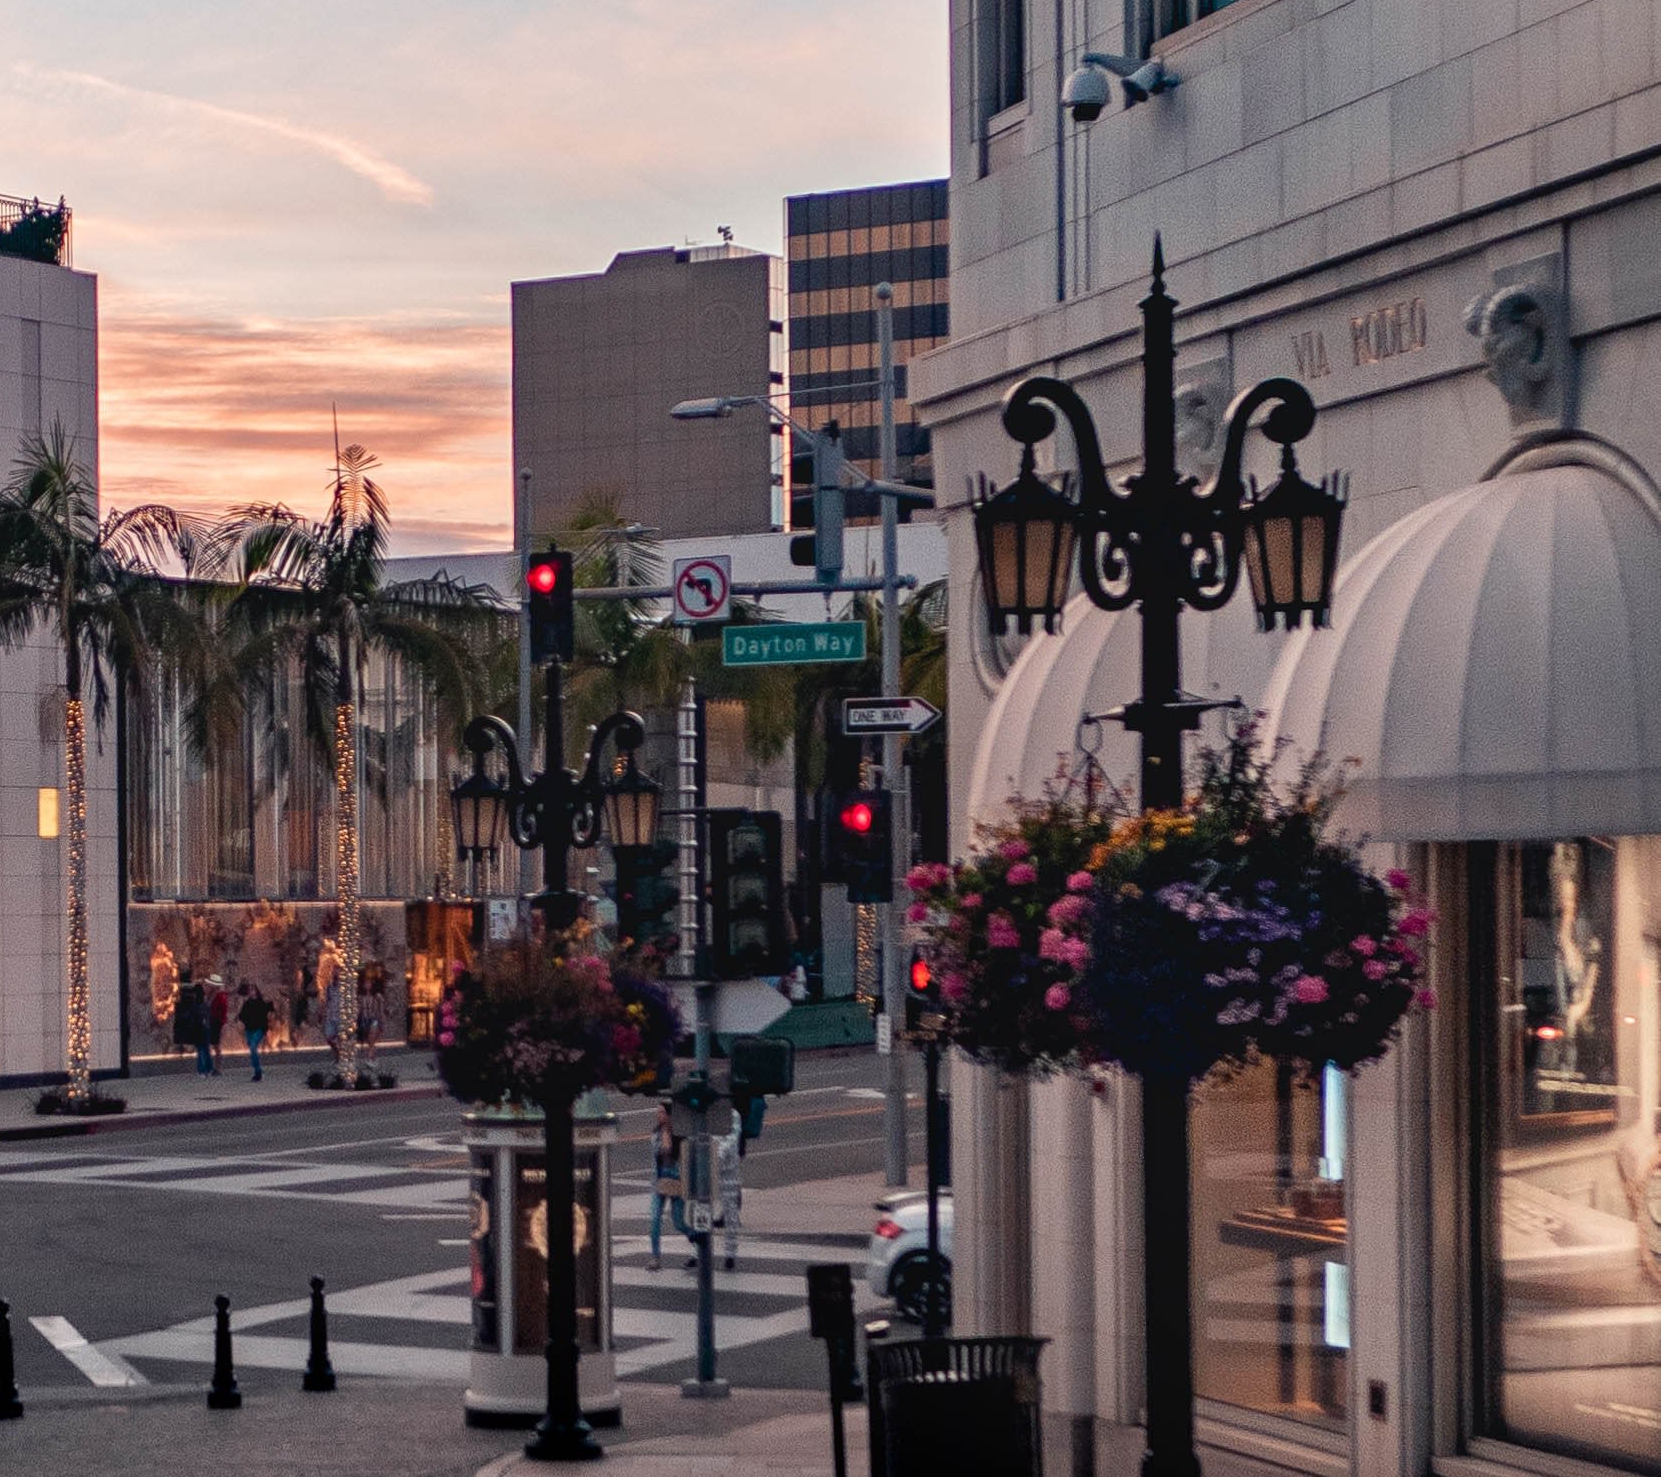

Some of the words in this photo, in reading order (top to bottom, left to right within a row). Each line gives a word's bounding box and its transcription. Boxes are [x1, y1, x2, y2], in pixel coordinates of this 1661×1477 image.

[1289, 329, 1331, 379] VIA
[1349, 297, 1427, 367] RODEO
[734, 634, 807, 660] Dayton
[813, 632, 855, 656] Way
[851, 710, 877, 723] ONE
[881, 709, 906, 722] WAY
